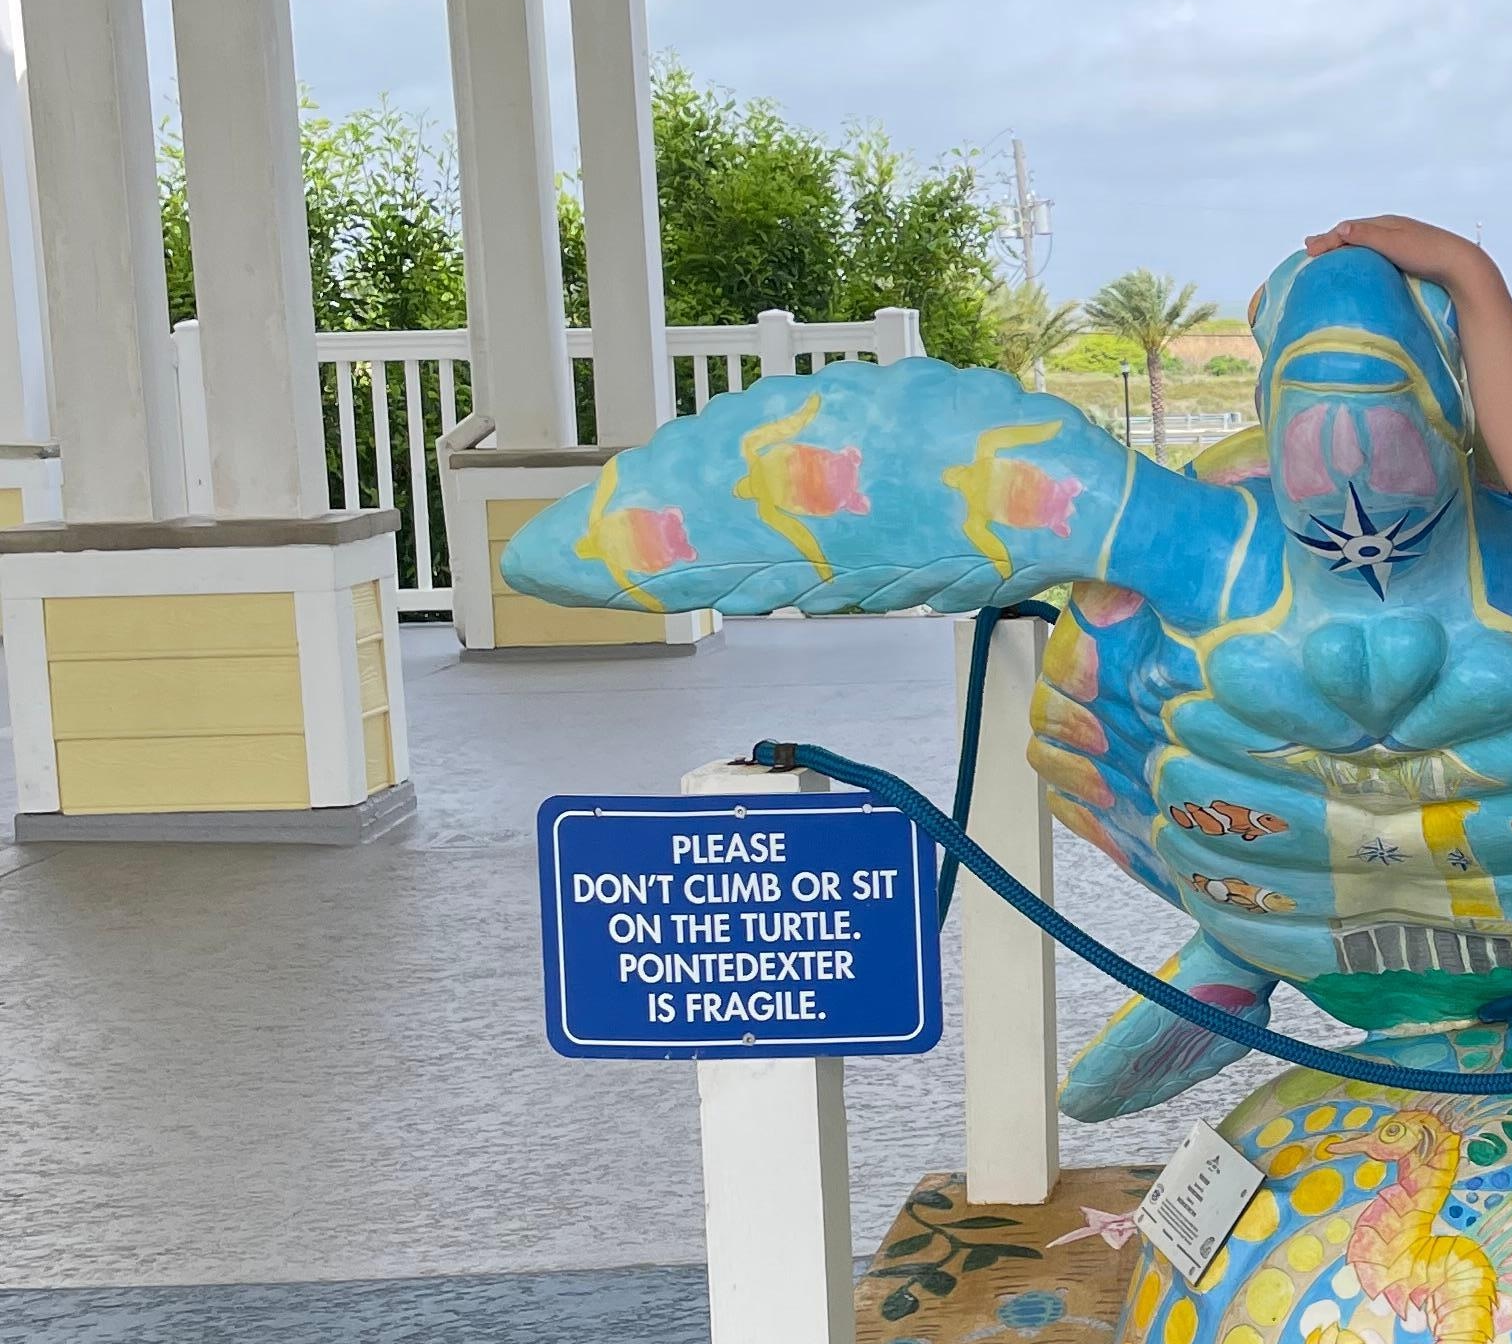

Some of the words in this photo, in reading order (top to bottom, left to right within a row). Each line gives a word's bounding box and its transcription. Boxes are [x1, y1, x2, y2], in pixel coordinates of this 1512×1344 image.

[672, 832, 787, 865] PLEASE
[573, 873, 674, 905] DON'T
[683, 872, 782, 905] CLIMB
[791, 870, 843, 902] OR
[852, 869, 898, 901] SIT
[608, 912, 663, 945] ON
[671, 913, 731, 944] THE
[740, 910, 862, 942] TURTLE.
[619, 950, 856, 984] POINTEDEXTER
[648, 992, 676, 1023] IS
[685, 990, 828, 1023] FRAGILE.
